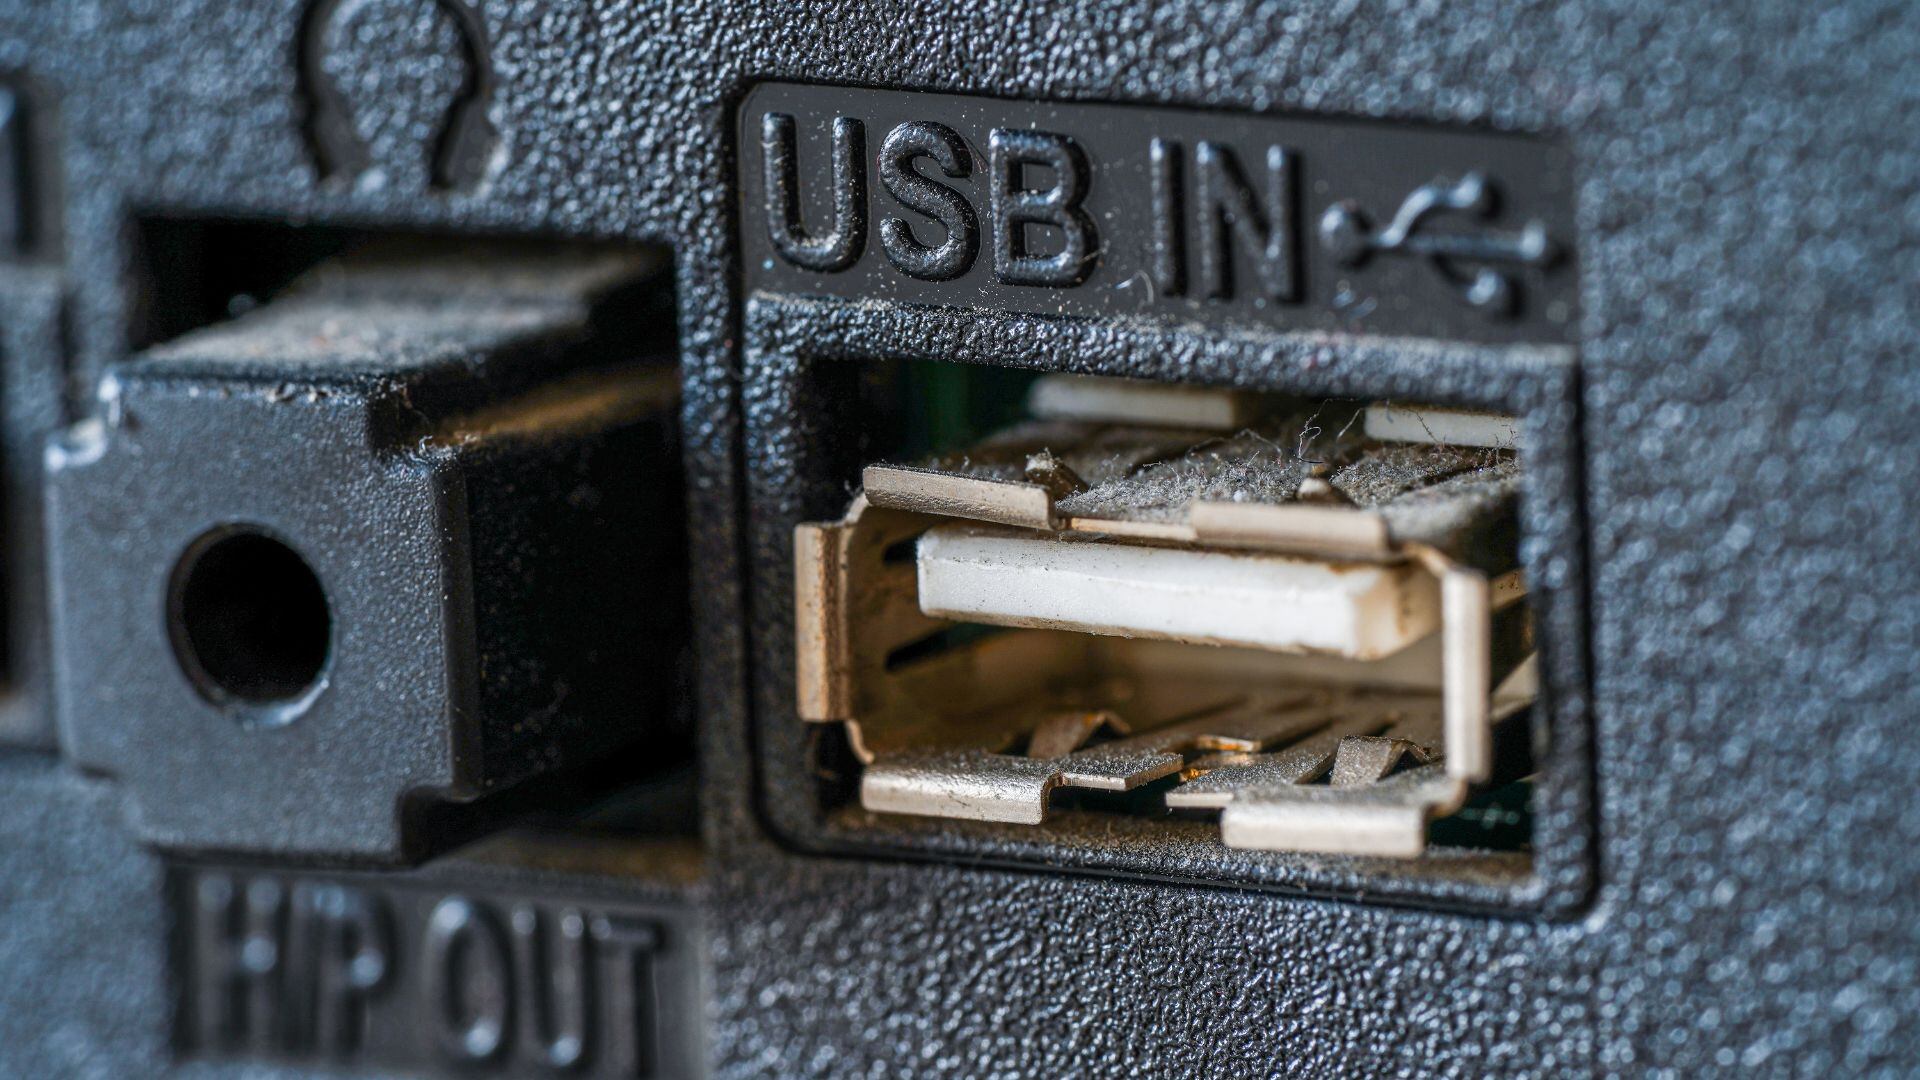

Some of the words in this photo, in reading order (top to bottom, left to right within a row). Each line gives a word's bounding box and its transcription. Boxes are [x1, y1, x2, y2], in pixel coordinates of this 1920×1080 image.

[760, 112, 1101, 288] USB
[1150, 136, 1304, 305] IN
[196, 874, 397, 1060] HP
[425, 895, 668, 1079] OUT
